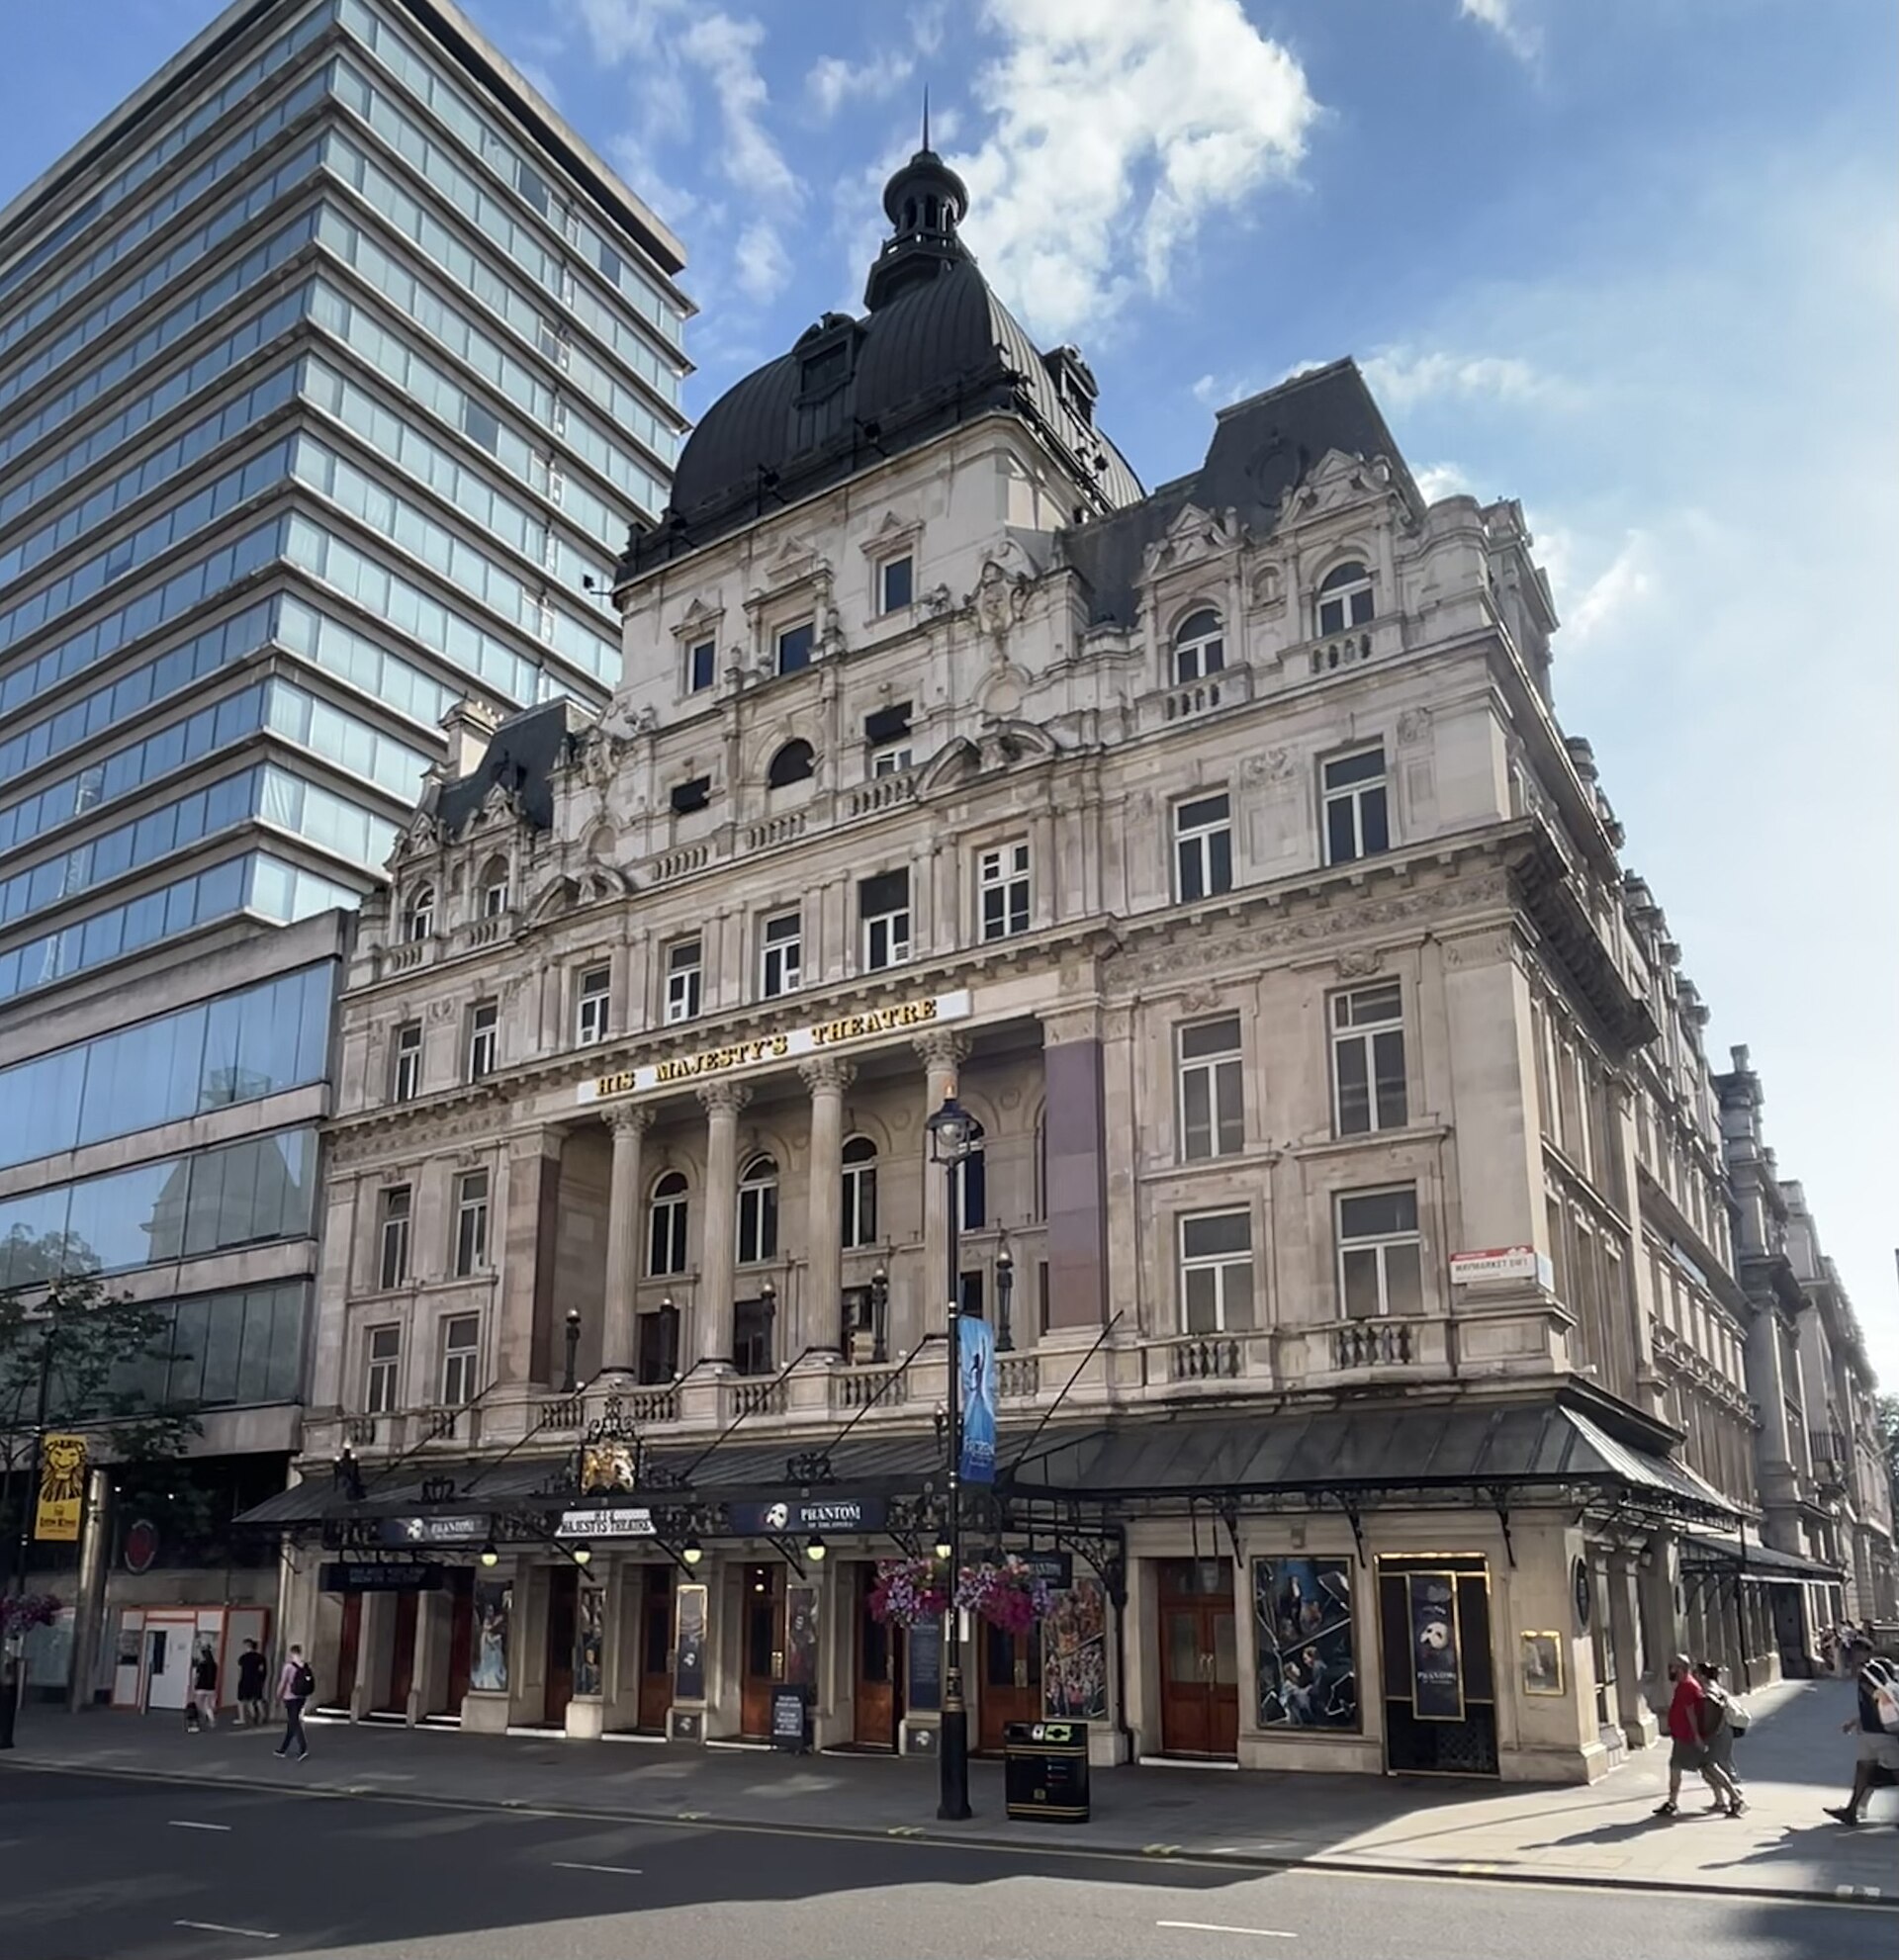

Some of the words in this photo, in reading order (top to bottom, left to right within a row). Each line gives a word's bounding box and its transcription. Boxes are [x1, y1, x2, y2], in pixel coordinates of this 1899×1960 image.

[596, 1072, 635, 1097] HIS
[656, 1033, 788, 1082] MAJESTY'S
[812, 998, 938, 1045] THEATRE
[1455, 1259, 1507, 1272] HAYMARKET
[801, 1506, 860, 1521] PHANTOM
